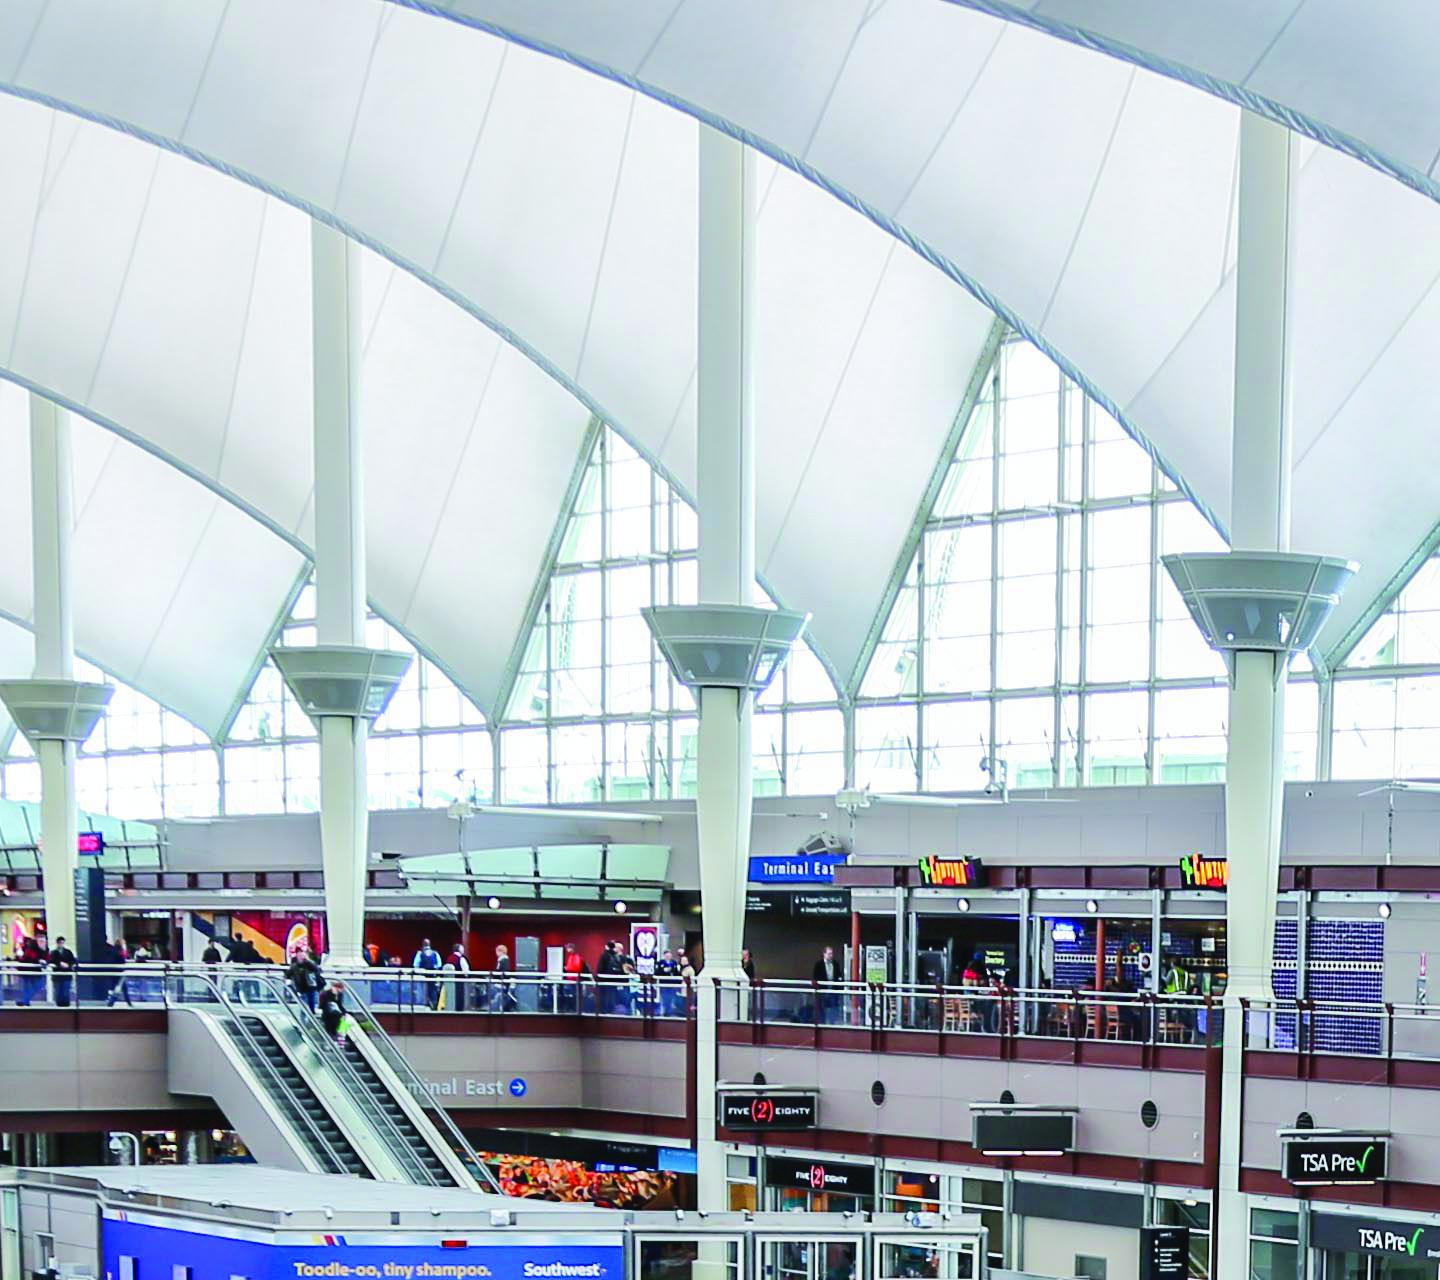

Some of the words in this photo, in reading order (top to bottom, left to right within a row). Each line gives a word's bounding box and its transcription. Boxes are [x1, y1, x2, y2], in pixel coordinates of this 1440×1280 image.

[762, 861, 810, 876] Terminal
[728, 1106, 750, 1116] FIVE
[775, 1106, 811, 1116] EIGHTY
[1300, 1153, 1329, 1172] TSA
[1331, 1153, 1356, 1172] Pre
[1359, 1228, 1384, 1248] TSA
[1385, 1232, 1407, 1252] Pre
[293, 1261, 381, 1278] Toodle-oo,
[383, 1261, 413, 1280] tiny
[416, 1261, 492, 1280] shampoo.
[523, 1262, 602, 1278] Southwest
